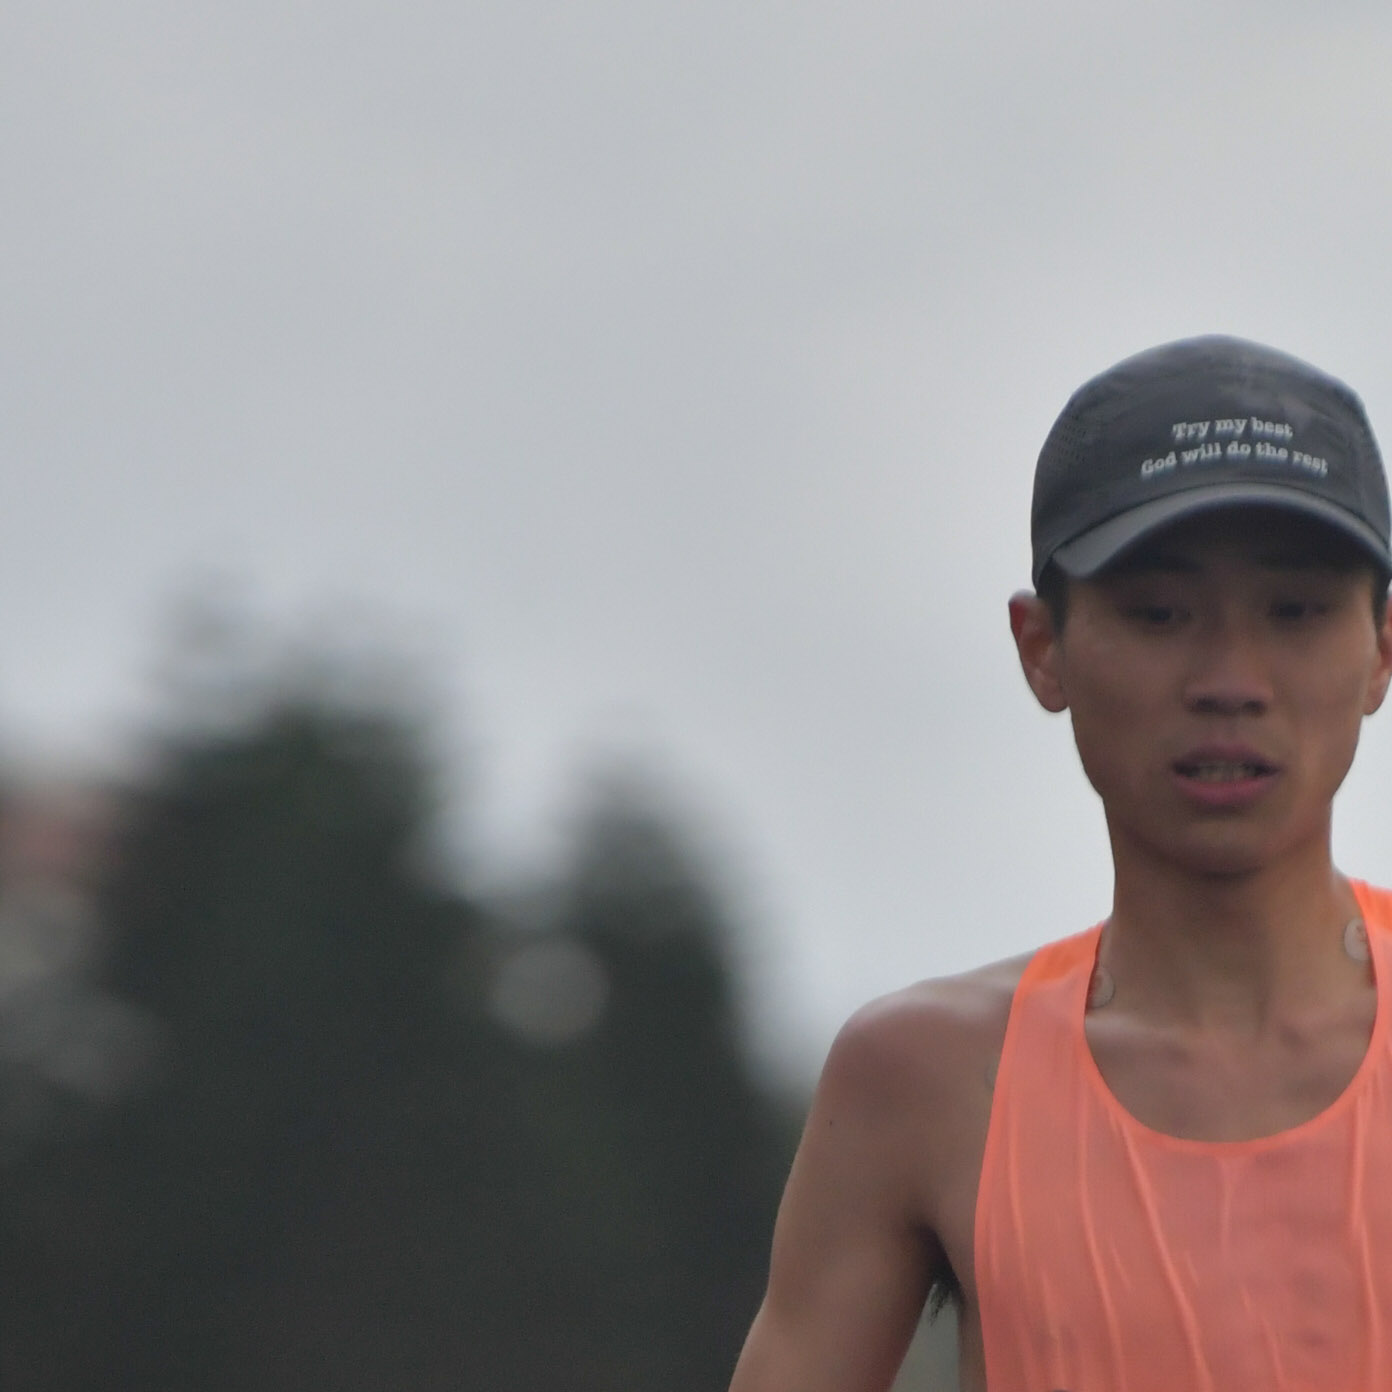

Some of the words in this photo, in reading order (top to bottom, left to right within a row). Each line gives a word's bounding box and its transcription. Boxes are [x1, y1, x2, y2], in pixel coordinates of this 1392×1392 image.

[1173, 419, 1210, 438] Try
[1215, 418, 1247, 434] my
[1251, 416, 1293, 437] best
[1141, 452, 1177, 474] God
[1181, 442, 1222, 463] will
[1226, 441, 1251, 456] do
[1256, 441, 1288, 459] the
[1293, 450, 1329, 473] rest
